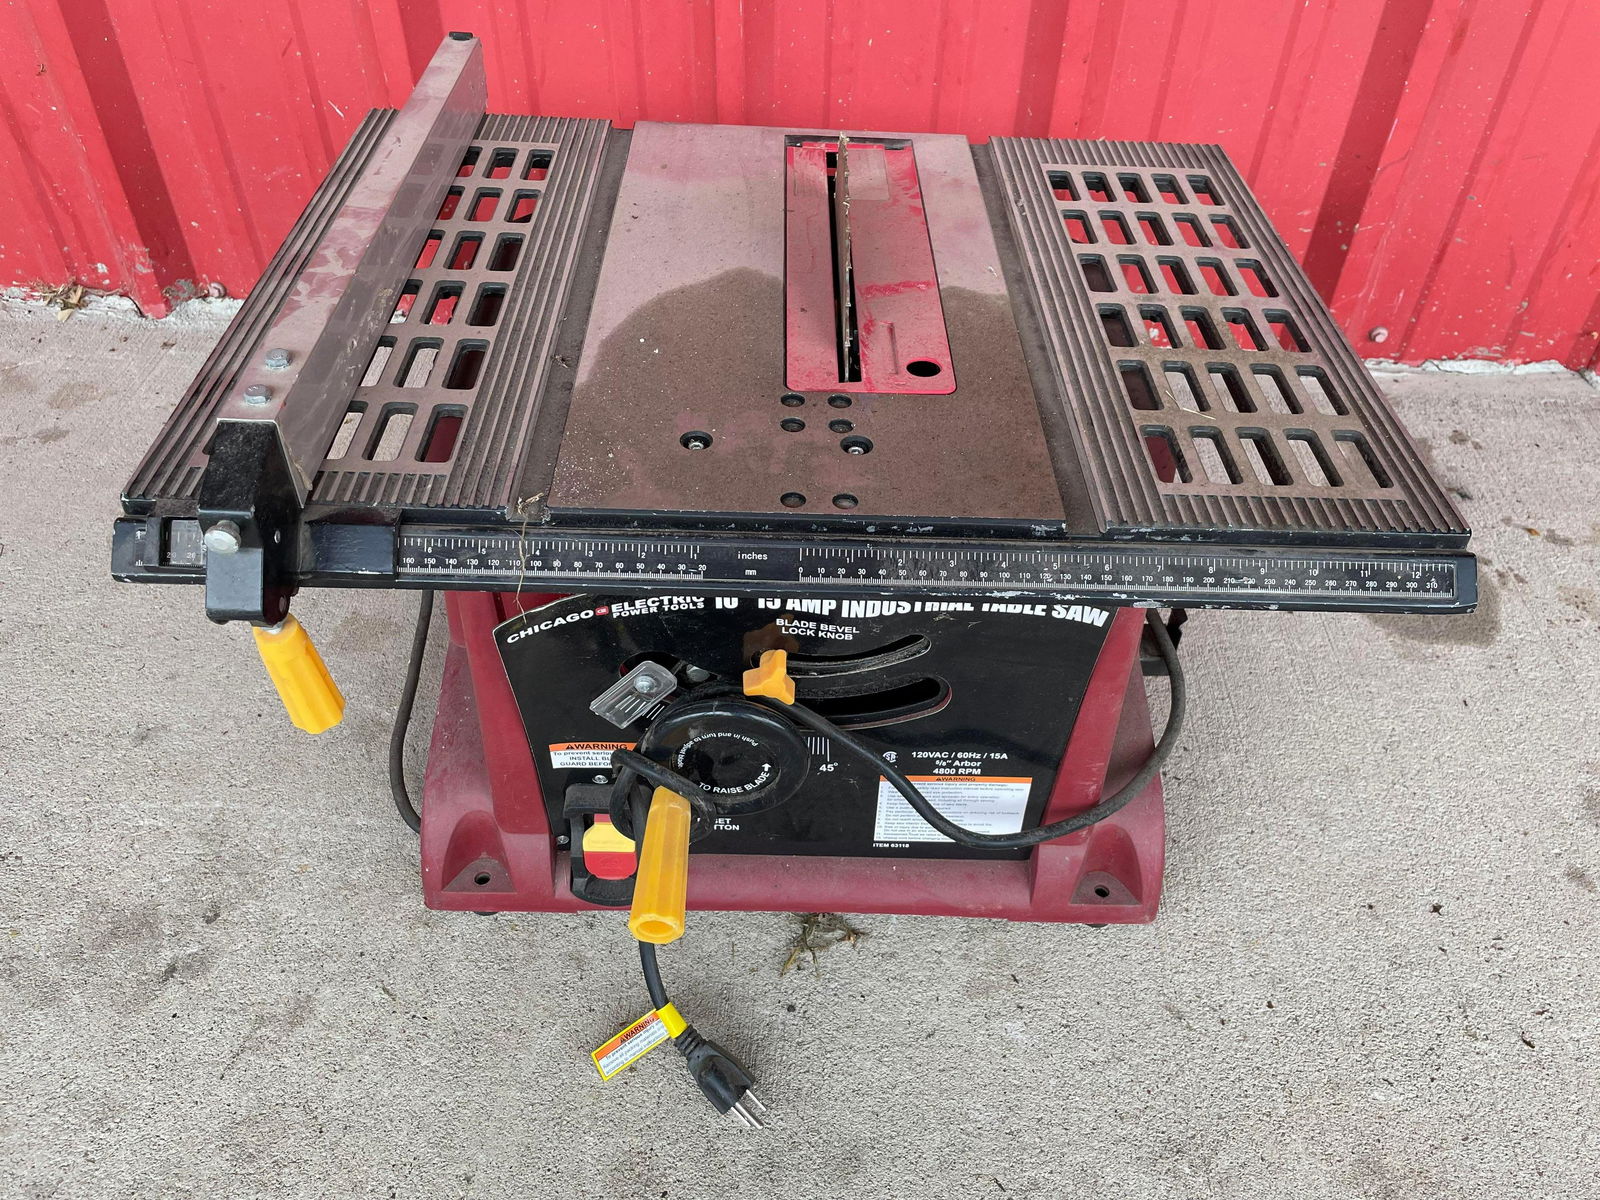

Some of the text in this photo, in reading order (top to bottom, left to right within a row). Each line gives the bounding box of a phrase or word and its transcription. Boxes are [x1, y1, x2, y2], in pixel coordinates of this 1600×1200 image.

[738, 551, 768, 560] inches
[613, 606, 658, 618] POWER
[662, 602, 704, 611] TOOLS
[1052, 605, 1109, 628] SAW
[507, 610, 594, 644] CHICAGO
[776, 618, 860, 633] BLADE BEVEL
[781, 627, 853, 640] LOCK KNOB
[742, 736, 758, 746] Push
[699, 782, 711, 790] TO
[744, 771, 769, 790] BLADE
[624, 1017, 655, 1040] WARNING
